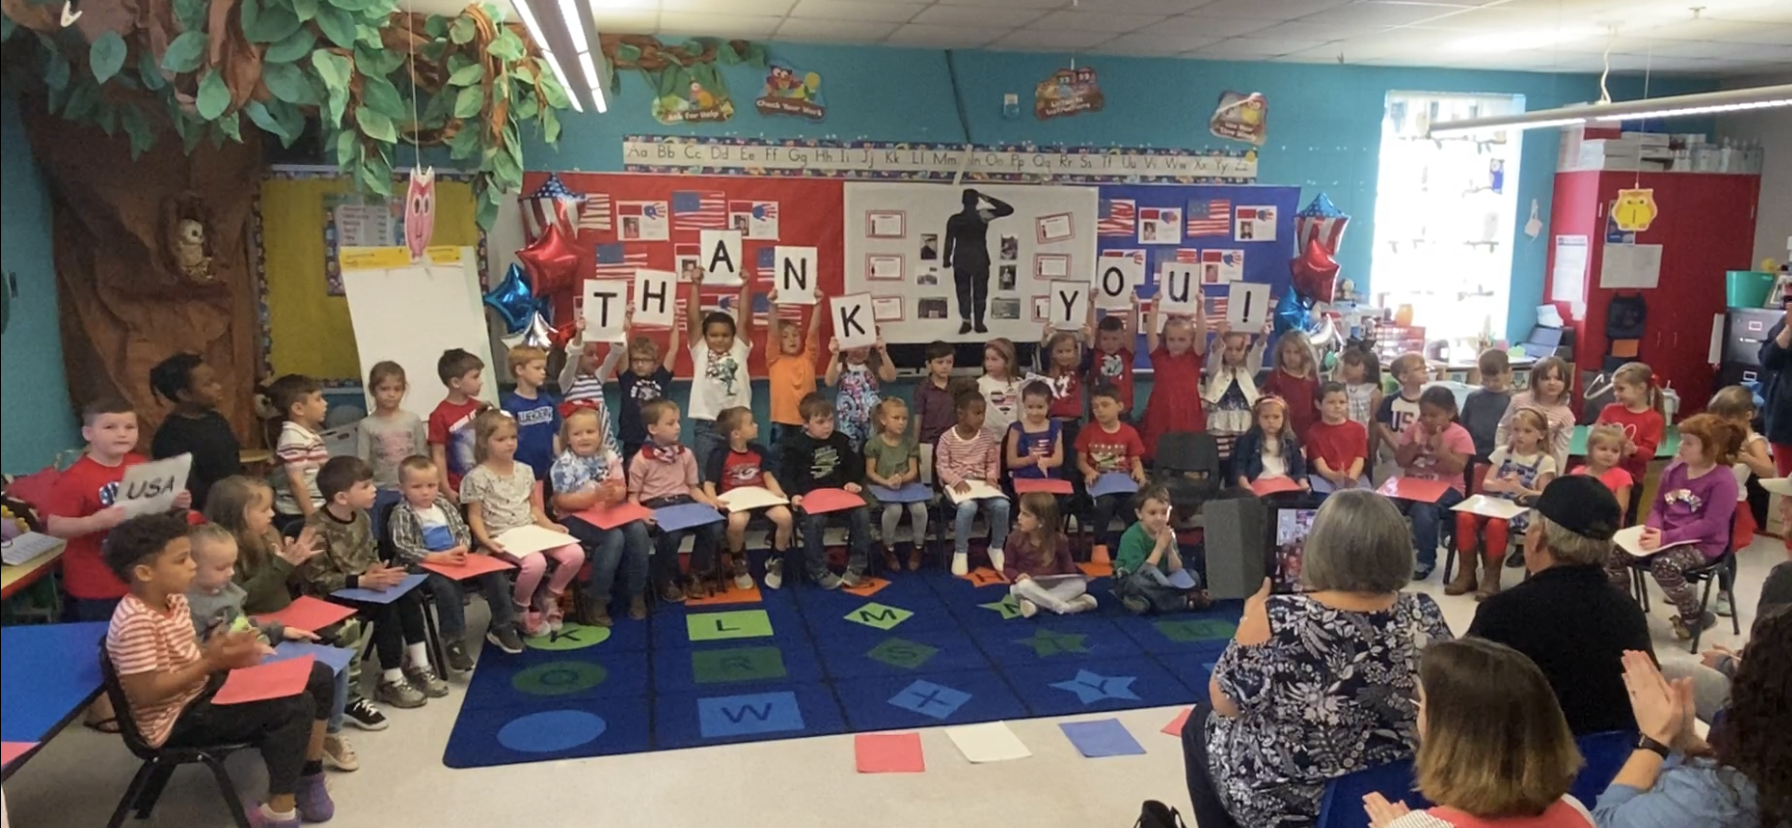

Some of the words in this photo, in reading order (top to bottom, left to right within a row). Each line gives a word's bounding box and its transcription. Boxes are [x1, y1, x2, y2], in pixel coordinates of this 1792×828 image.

[628, 144, 647, 158] Aa
[658, 144, 675, 159] Bb
[684, 145, 702, 159] Cc
[711, 146, 728, 160] Dd
[740, 147, 755, 161] Ee
[766, 147, 777, 161] Ff
[788, 149, 807, 168] Gg
[815, 149, 832, 163] Hh
[840, 150, 850, 163] Ii
[861, 150, 874, 169] Jj
[886, 151, 900, 163] Kk
[912, 151, 924, 164] Ll
[933, 152, 957, 165] Mm
[1011, 154, 1024, 171] Pp
[1060, 155, 1072, 168] Rr
[1080, 155, 1092, 168] Ss
[1102, 155, 1112, 168] Tt
[1122, 156, 1136, 169] Uu
[1166, 157, 1186, 170] Ww
[1194, 158, 1207, 170] Xx
[1215, 158, 1227, 174] Yy
[709, 240, 734, 273] A
[784, 257, 806, 290] N
[1103, 266, 1124, 297] O
[593, 292, 618, 327] T
[642, 279, 666, 313] H
[1059, 290, 1079, 321] Y
[1242, 290, 1251, 323] !
[840, 304, 865, 337] K
[126, 475, 175, 500] USA
[716, 618, 741, 631] L
[859, 608, 898, 623] M
[551, 628, 581, 643] K
[722, 703, 772, 724] W
[909, 688, 950, 708] X
